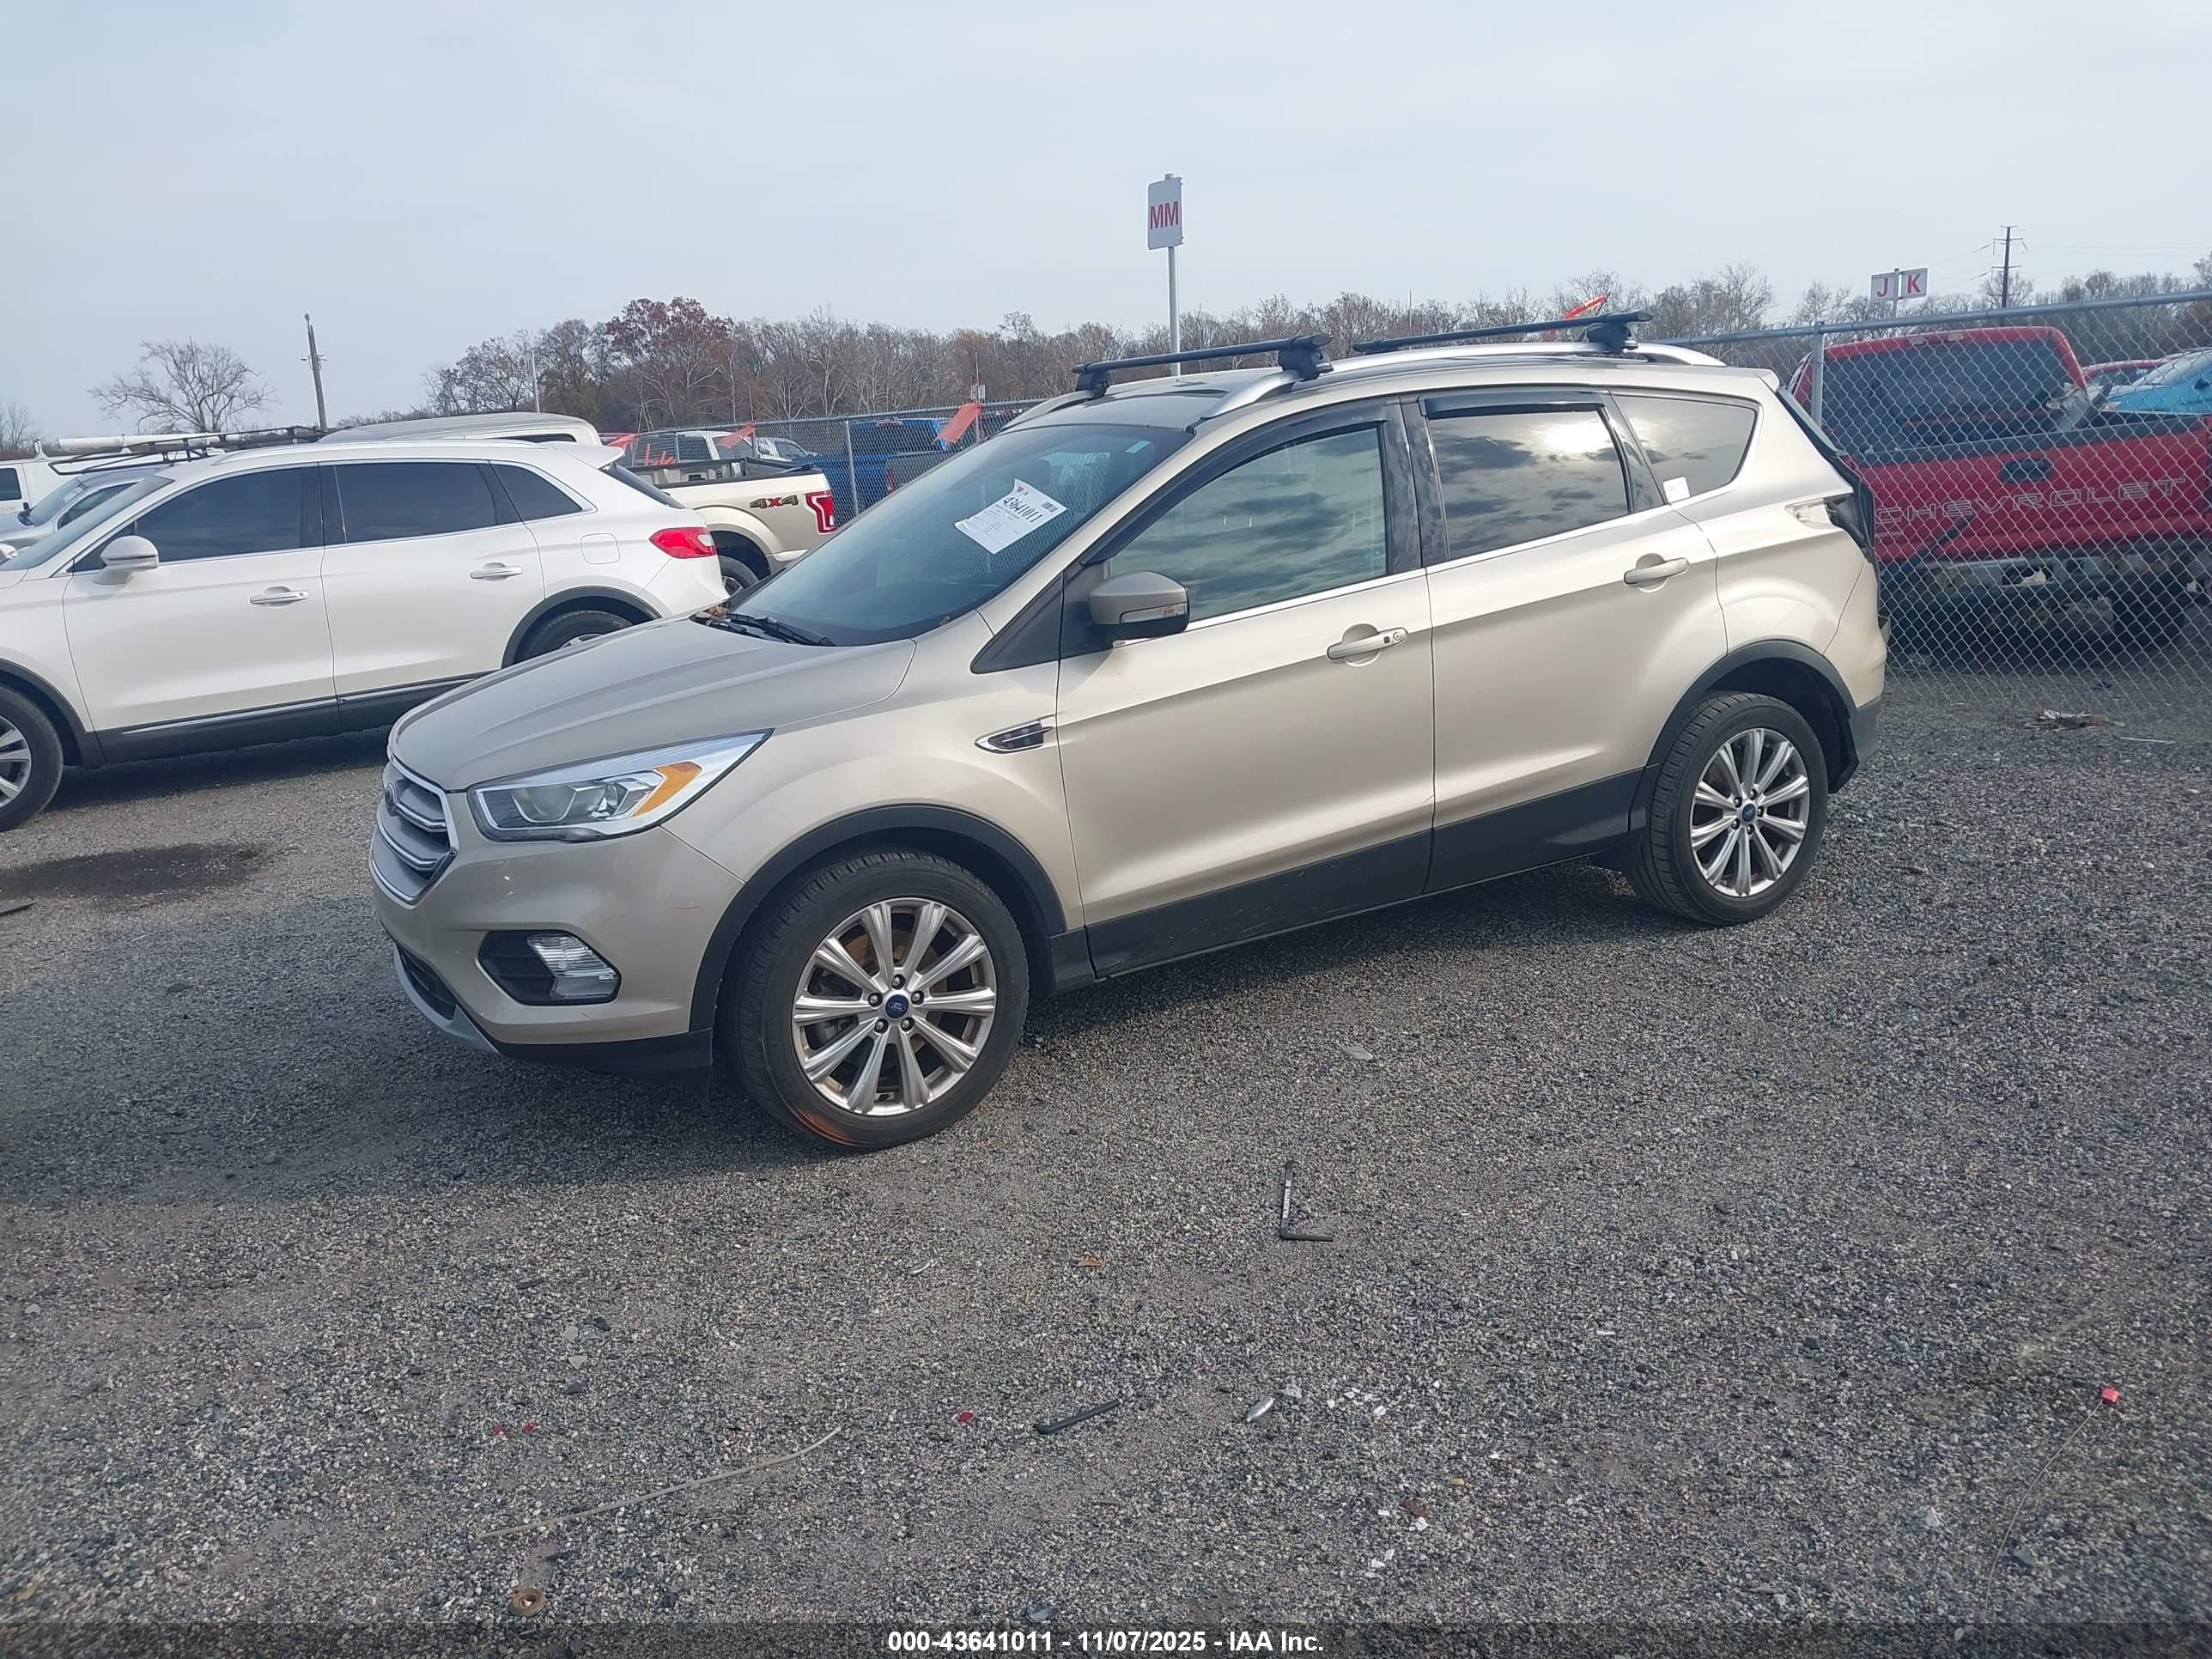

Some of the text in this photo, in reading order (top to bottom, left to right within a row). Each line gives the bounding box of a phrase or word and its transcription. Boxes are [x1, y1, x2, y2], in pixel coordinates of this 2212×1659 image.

[1150, 200, 1179, 230] MM
[1876, 277, 1888, 297] J
[1907, 273, 1921, 294] K
[1003, 496, 1043, 523] 43641011
[1875, 477, 2186, 524] CHEVROLET
